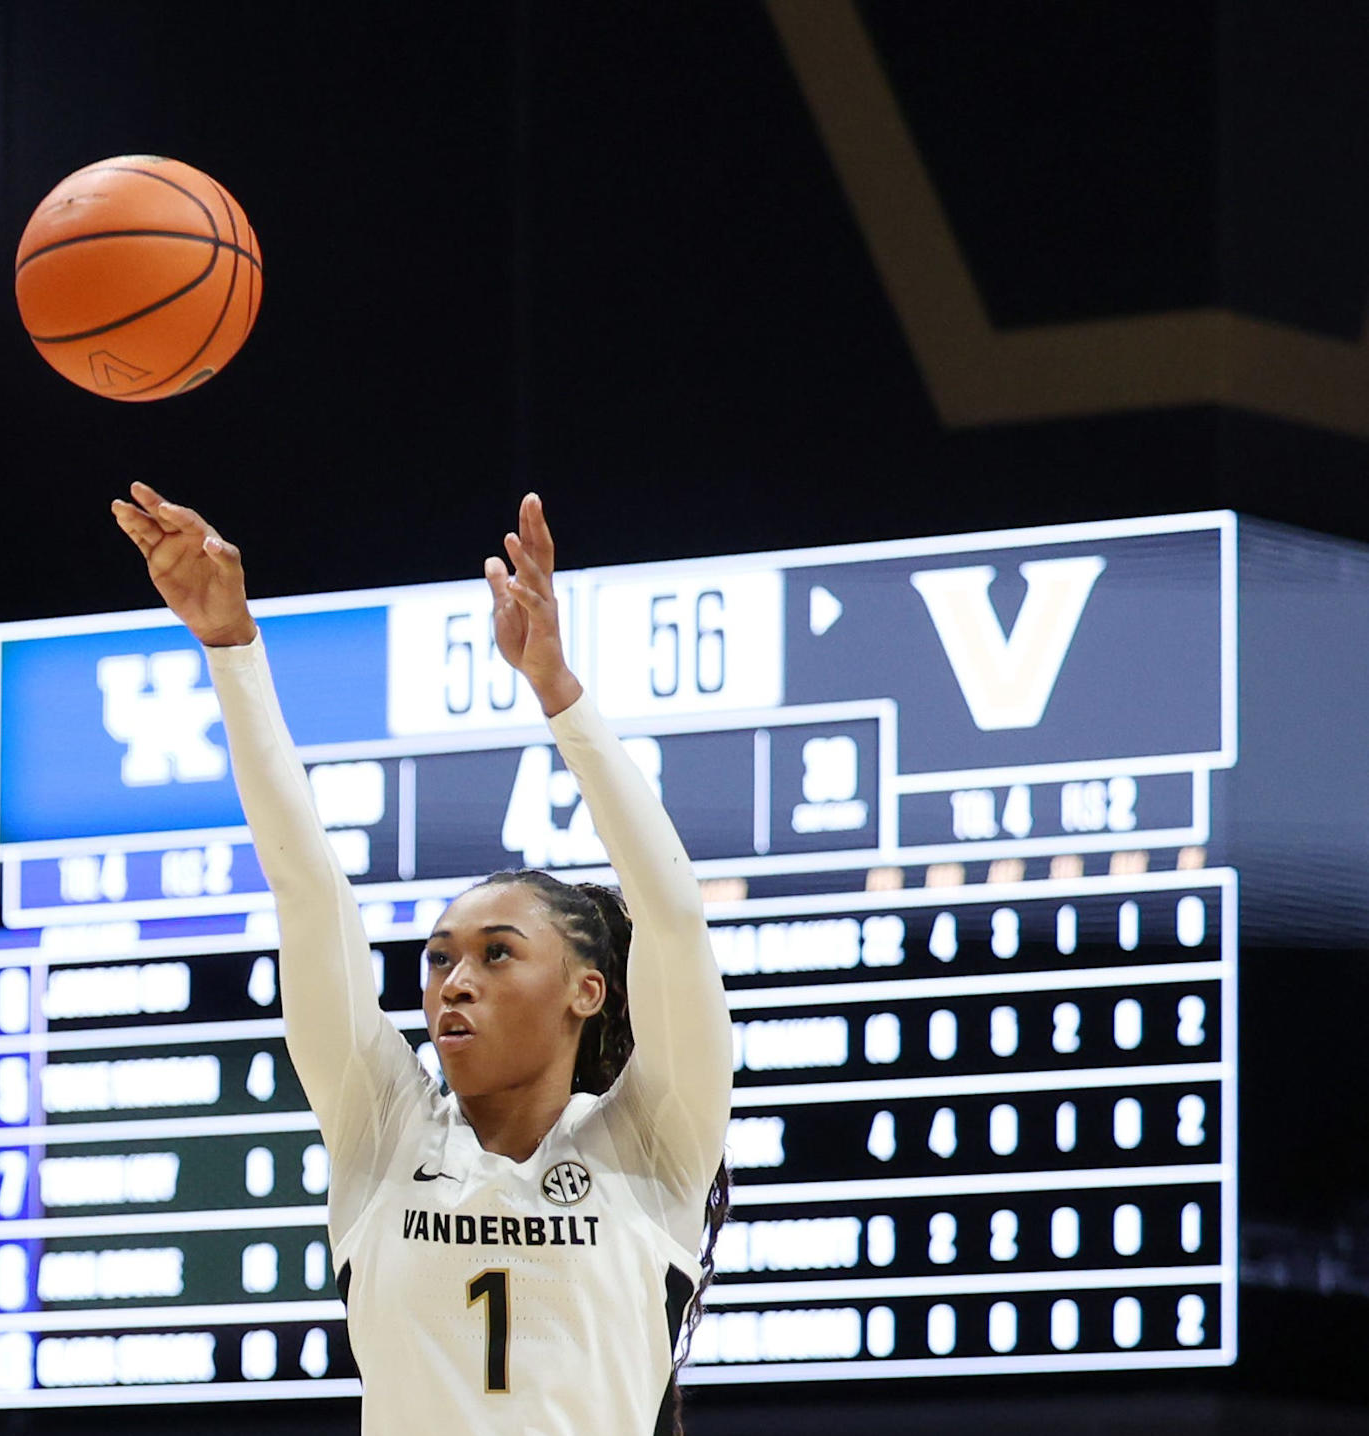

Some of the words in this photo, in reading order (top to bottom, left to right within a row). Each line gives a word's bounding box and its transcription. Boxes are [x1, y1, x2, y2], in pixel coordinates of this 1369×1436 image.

[648, 589, 725, 698] 56
[909, 555, 1107, 731] V
[402, 1209, 599, 1246] VANDERBILT
[543, 1162, 591, 1204] SEC
[466, 1267, 511, 1395] 1
